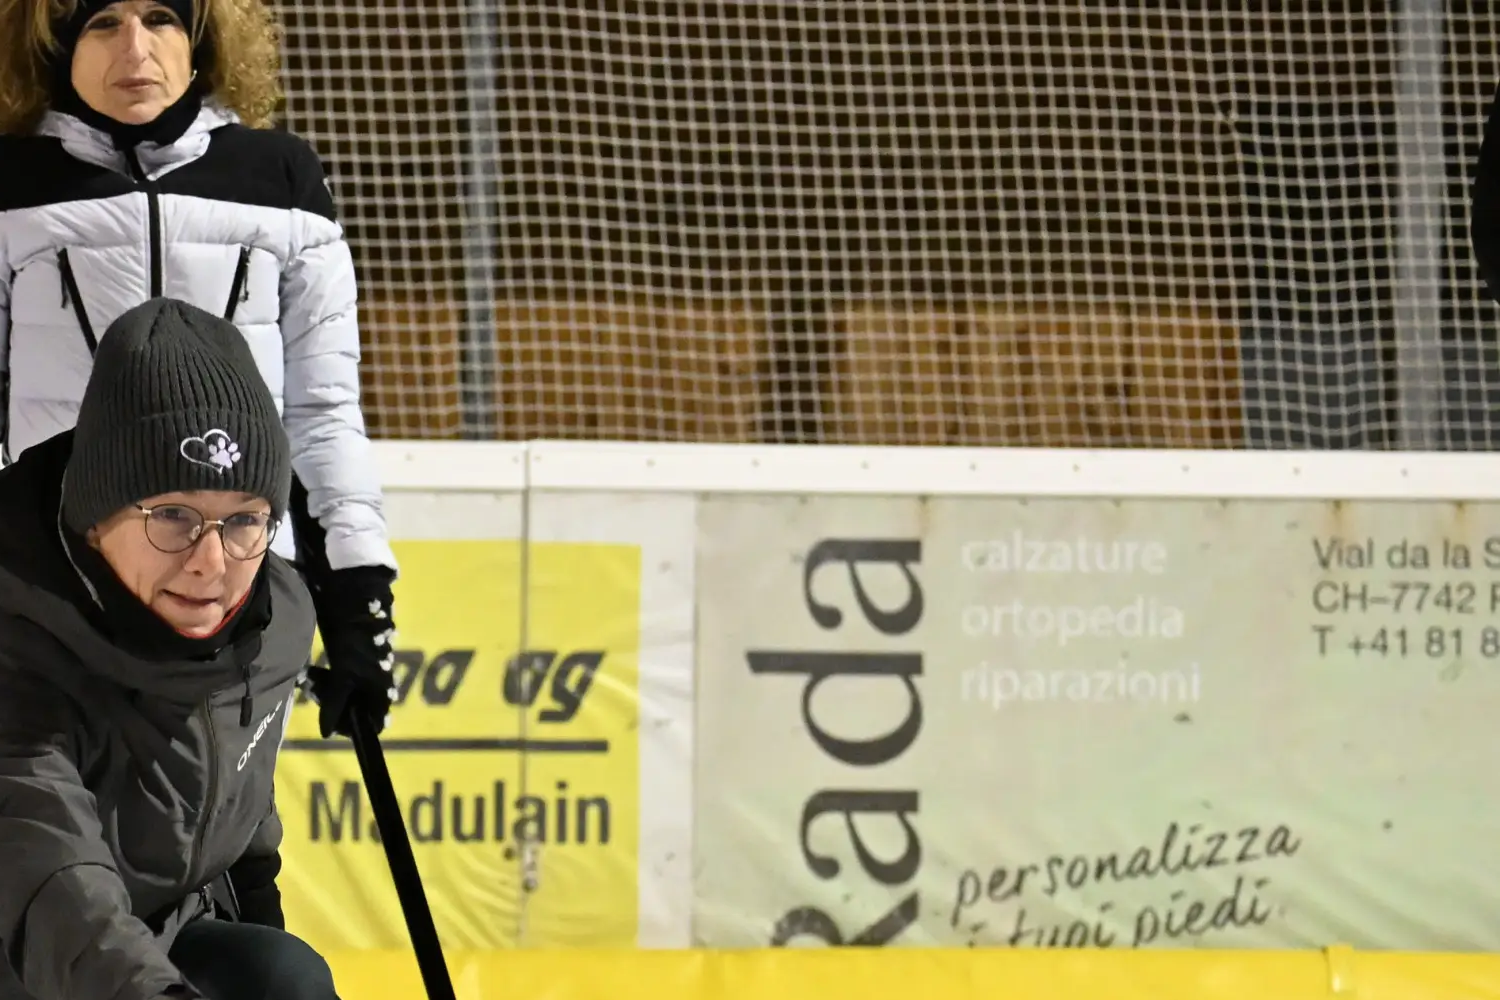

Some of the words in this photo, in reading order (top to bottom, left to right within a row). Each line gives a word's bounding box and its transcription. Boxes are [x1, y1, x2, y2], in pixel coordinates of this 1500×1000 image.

[961, 529, 1168, 574] calzature
[1312, 537, 1375, 570] Vial
[1386, 537, 1430, 570] da
[1443, 537, 1472, 570] la
[961, 594, 1186, 647] ortopedia
[1311, 624, 1335, 657] T
[1348, 625, 1408, 658] +41
[1425, 625, 1462, 658] 81
[503, 650, 606, 723] ag
[961, 660, 1203, 710] riparazioni
[950, 821, 1303, 928] personalizza
